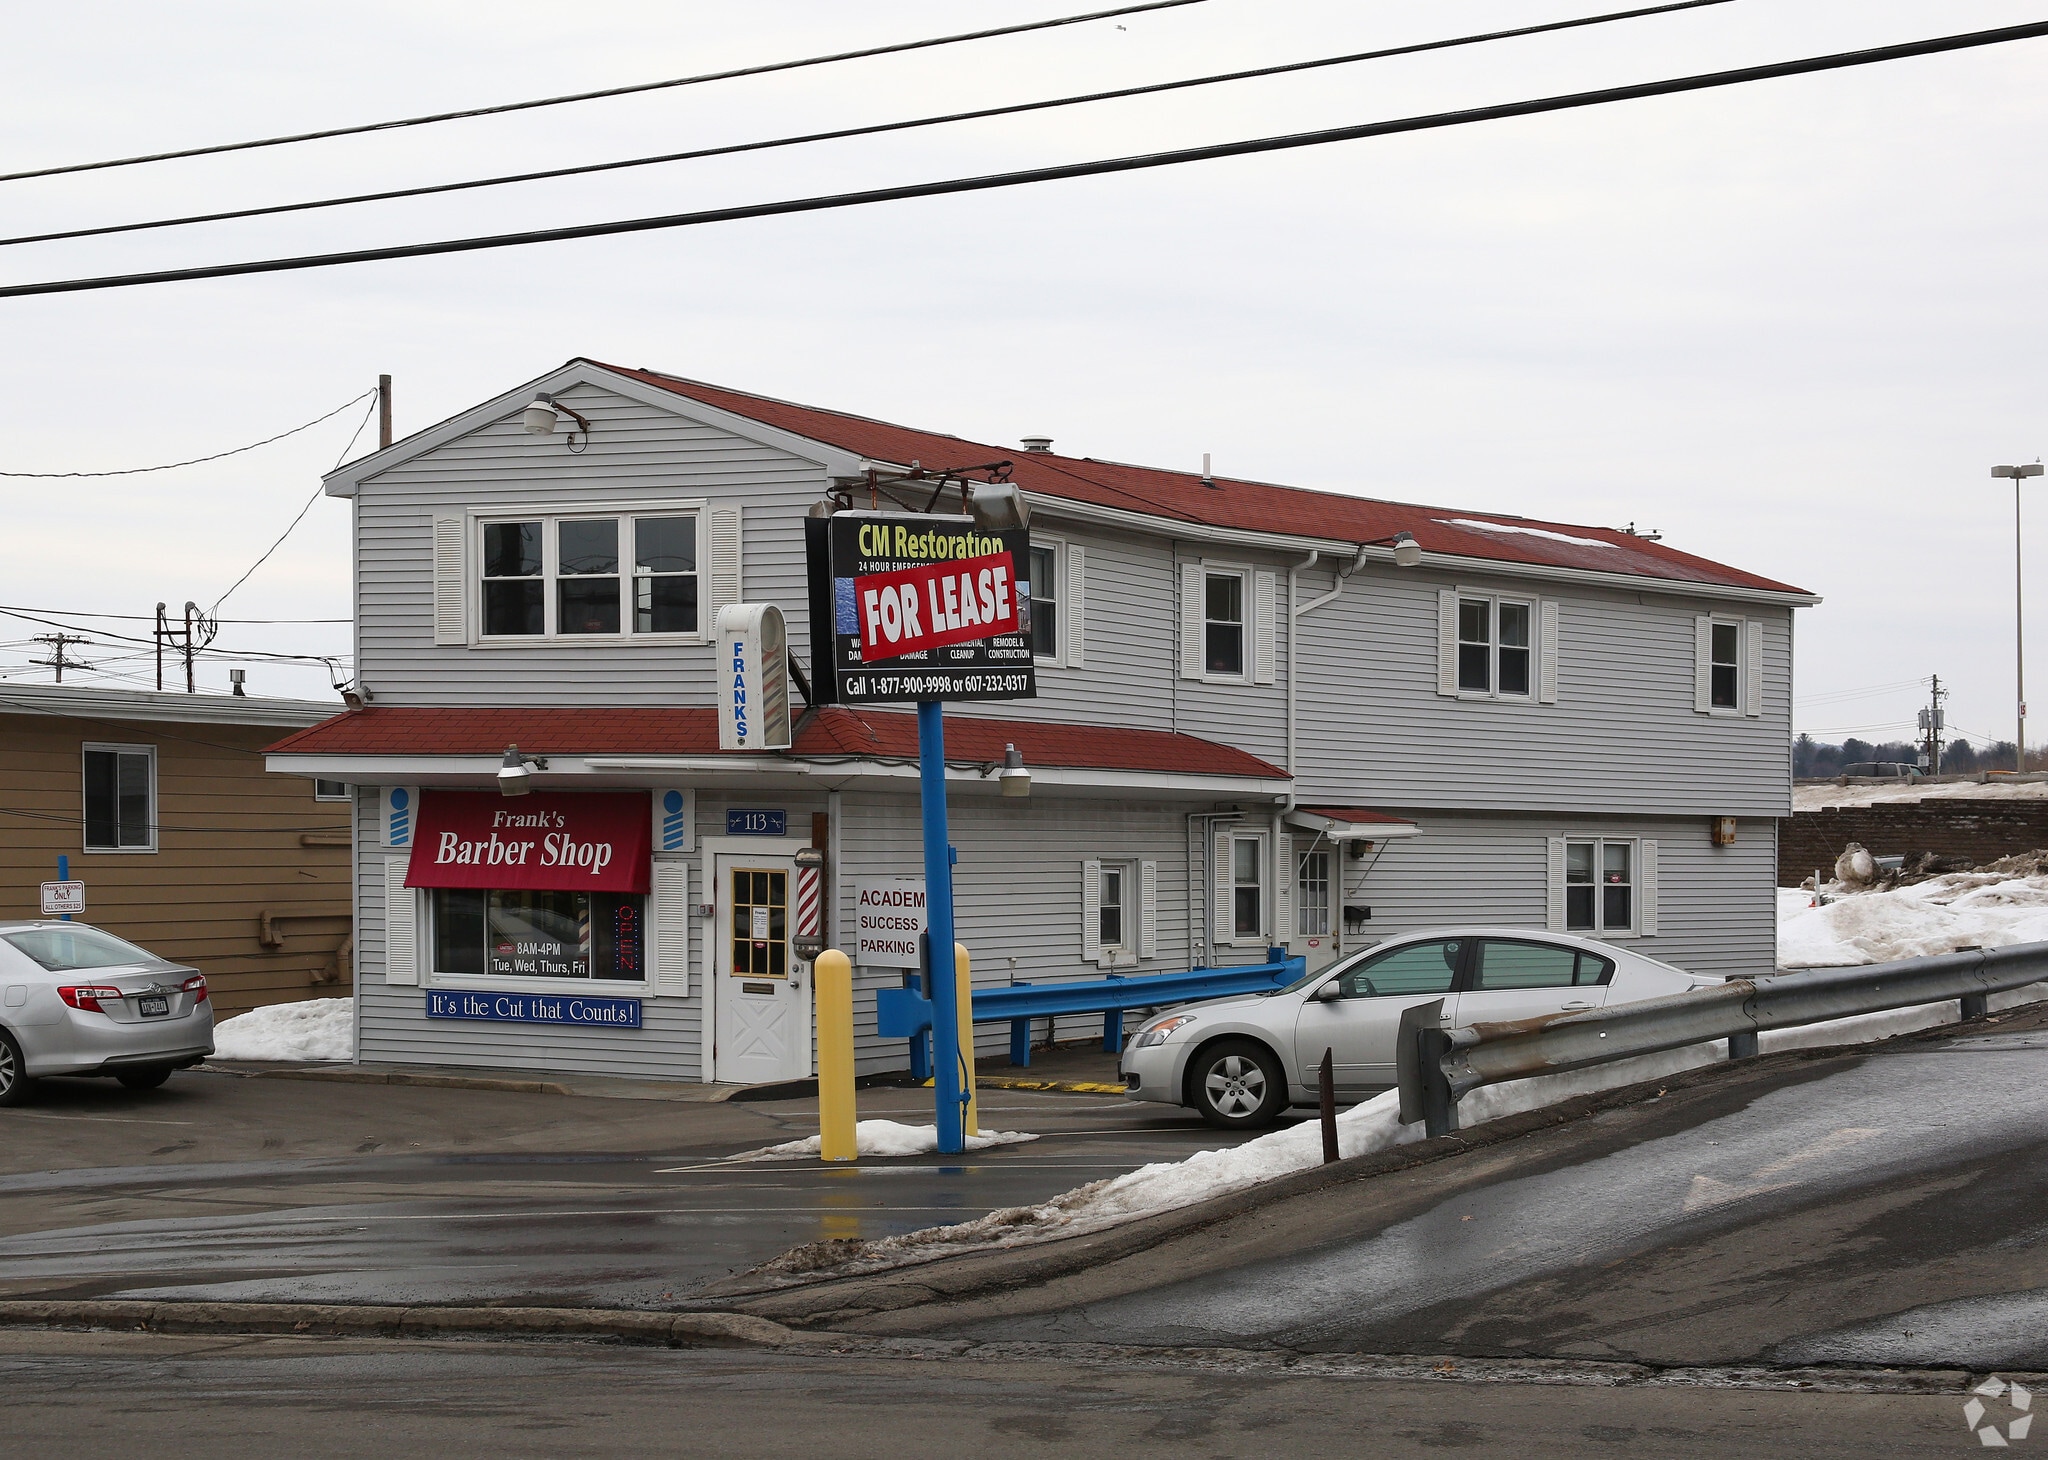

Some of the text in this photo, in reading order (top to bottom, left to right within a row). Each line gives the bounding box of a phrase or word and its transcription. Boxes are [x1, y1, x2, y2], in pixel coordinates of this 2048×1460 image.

[858, 524, 1004, 559] CM Restoration
[858, 561, 868, 571] 24
[869, 561, 890, 572] HOUR
[863, 566, 1011, 646] FOR LEASE
[992, 637, 1025, 647] REMODEL &
[900, 650, 929, 660] DAMAGE
[950, 649, 975, 660] CLEANUP
[988, 649, 1030, 659] CONSTRUCTION
[732, 642, 748, 737] FRANKS
[846, 674, 1028, 695] Call 1-877-900-9998 or 607-232-0317
[491, 810, 565, 828] Frank's
[744, 813, 767, 831] 113
[434, 831, 613, 875] Barber Shop
[54, 892, 71, 900] ONLY
[860, 889, 925, 908] ACADEM
[860, 915, 919, 931] SUCCESS
[618, 905, 634, 970] OPEN
[860, 938, 915, 954] PARKING
[517, 942, 561, 956] 8AM-4PM
[493, 958, 586, 975] Tue, Wed, Thurs, Fri
[432, 995, 634, 1023] It's the Cut that Counts!
